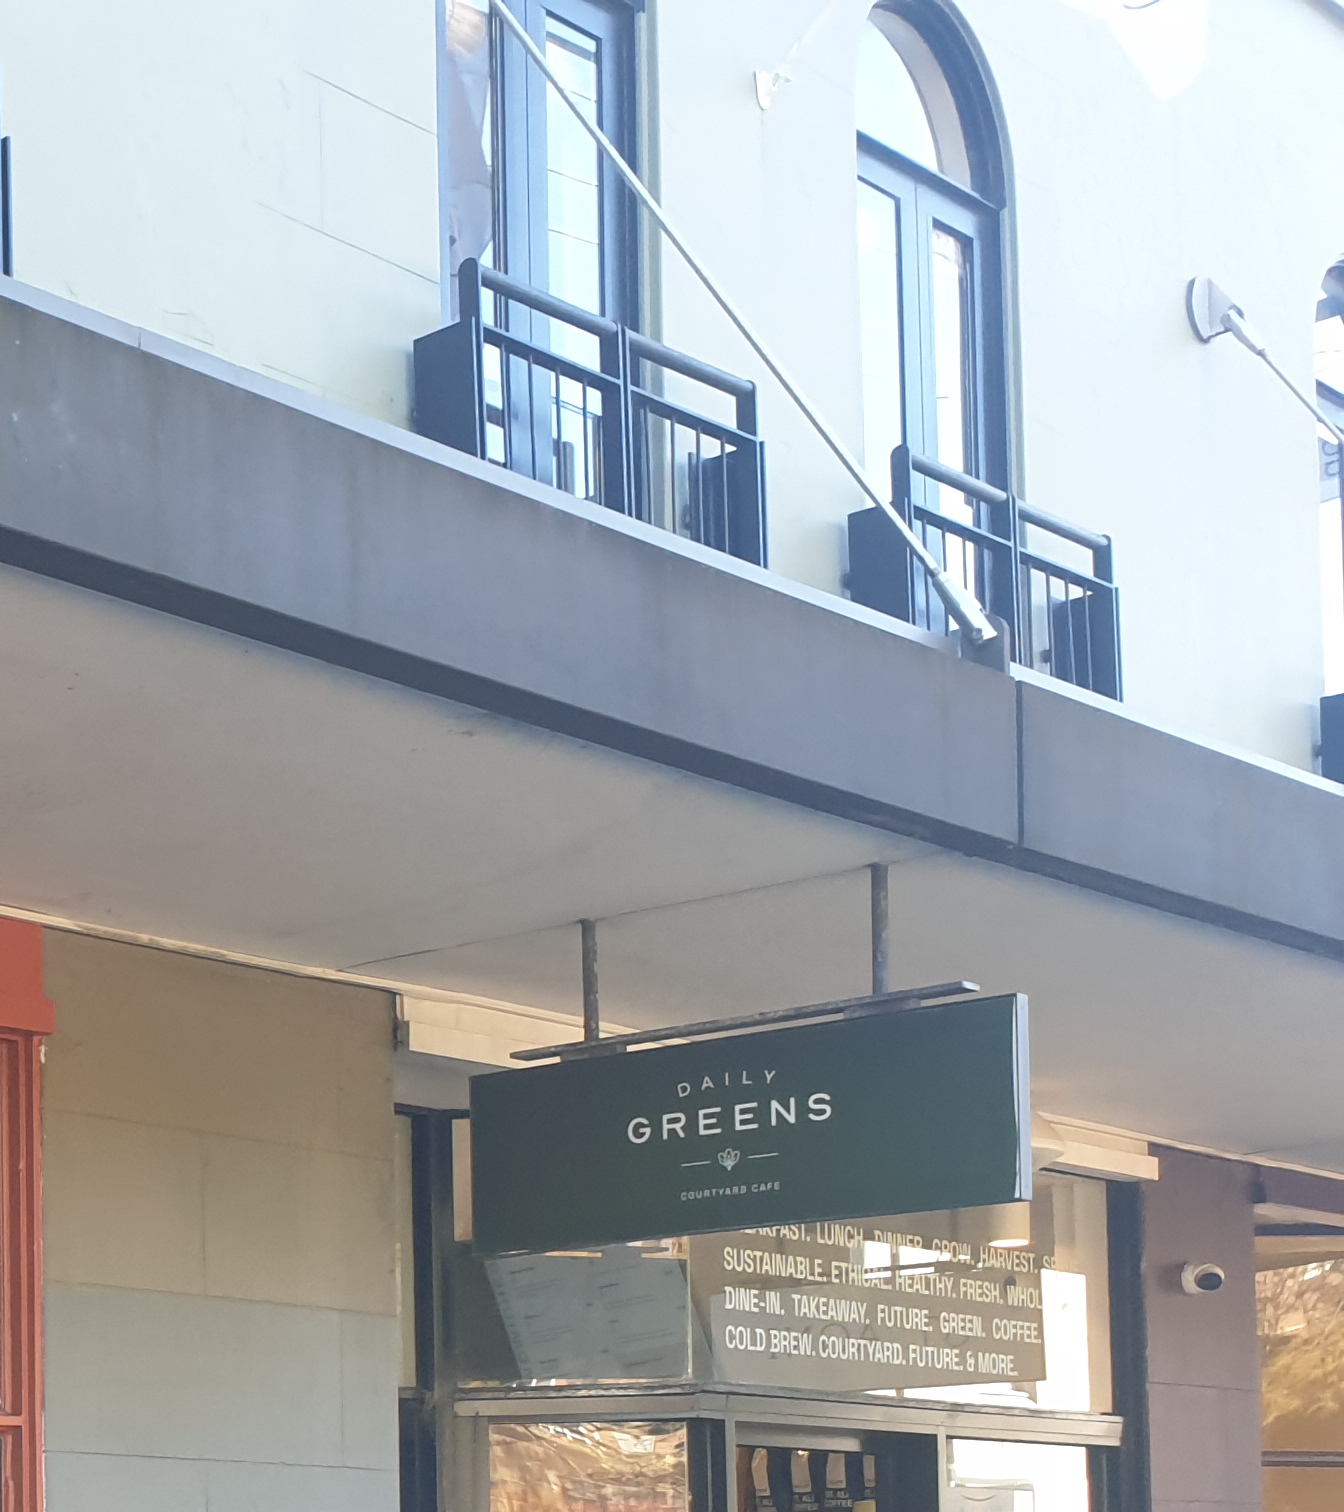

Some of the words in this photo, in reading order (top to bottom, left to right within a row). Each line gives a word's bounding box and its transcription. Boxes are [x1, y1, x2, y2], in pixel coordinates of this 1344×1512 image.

[676, 1069, 777, 1098] DAILY
[627, 1092, 832, 1144] GREENS
[680, 1184, 748, 1202] COURTYARD
[751, 1181, 781, 1193] CAFE
[723, 1246, 827, 1282] SUSTAINABLE.
[895, 1272, 957, 1299] HEALTHY.
[959, 1278, 1004, 1305] FRESH.
[979, 1246, 1039, 1274] HARVEST.
[724, 1286, 785, 1316] DINE-IN.
[791, 1294, 870, 1325] TAKEAWAY.
[877, 1304, 933, 1332] FUTURE.
[939, 1312, 986, 1338] GREEN.
[992, 1319, 1042, 1344] COFFEE.
[725, 1325, 766, 1352] COLD
[769, 1329, 816, 1357] BREW.
[818, 1335, 906, 1366] COURTYARD.
[908, 1345, 963, 1371] FUTURE.
[965, 1351, 975, 1372] &
[977, 1353, 1019, 1376] MORE.
